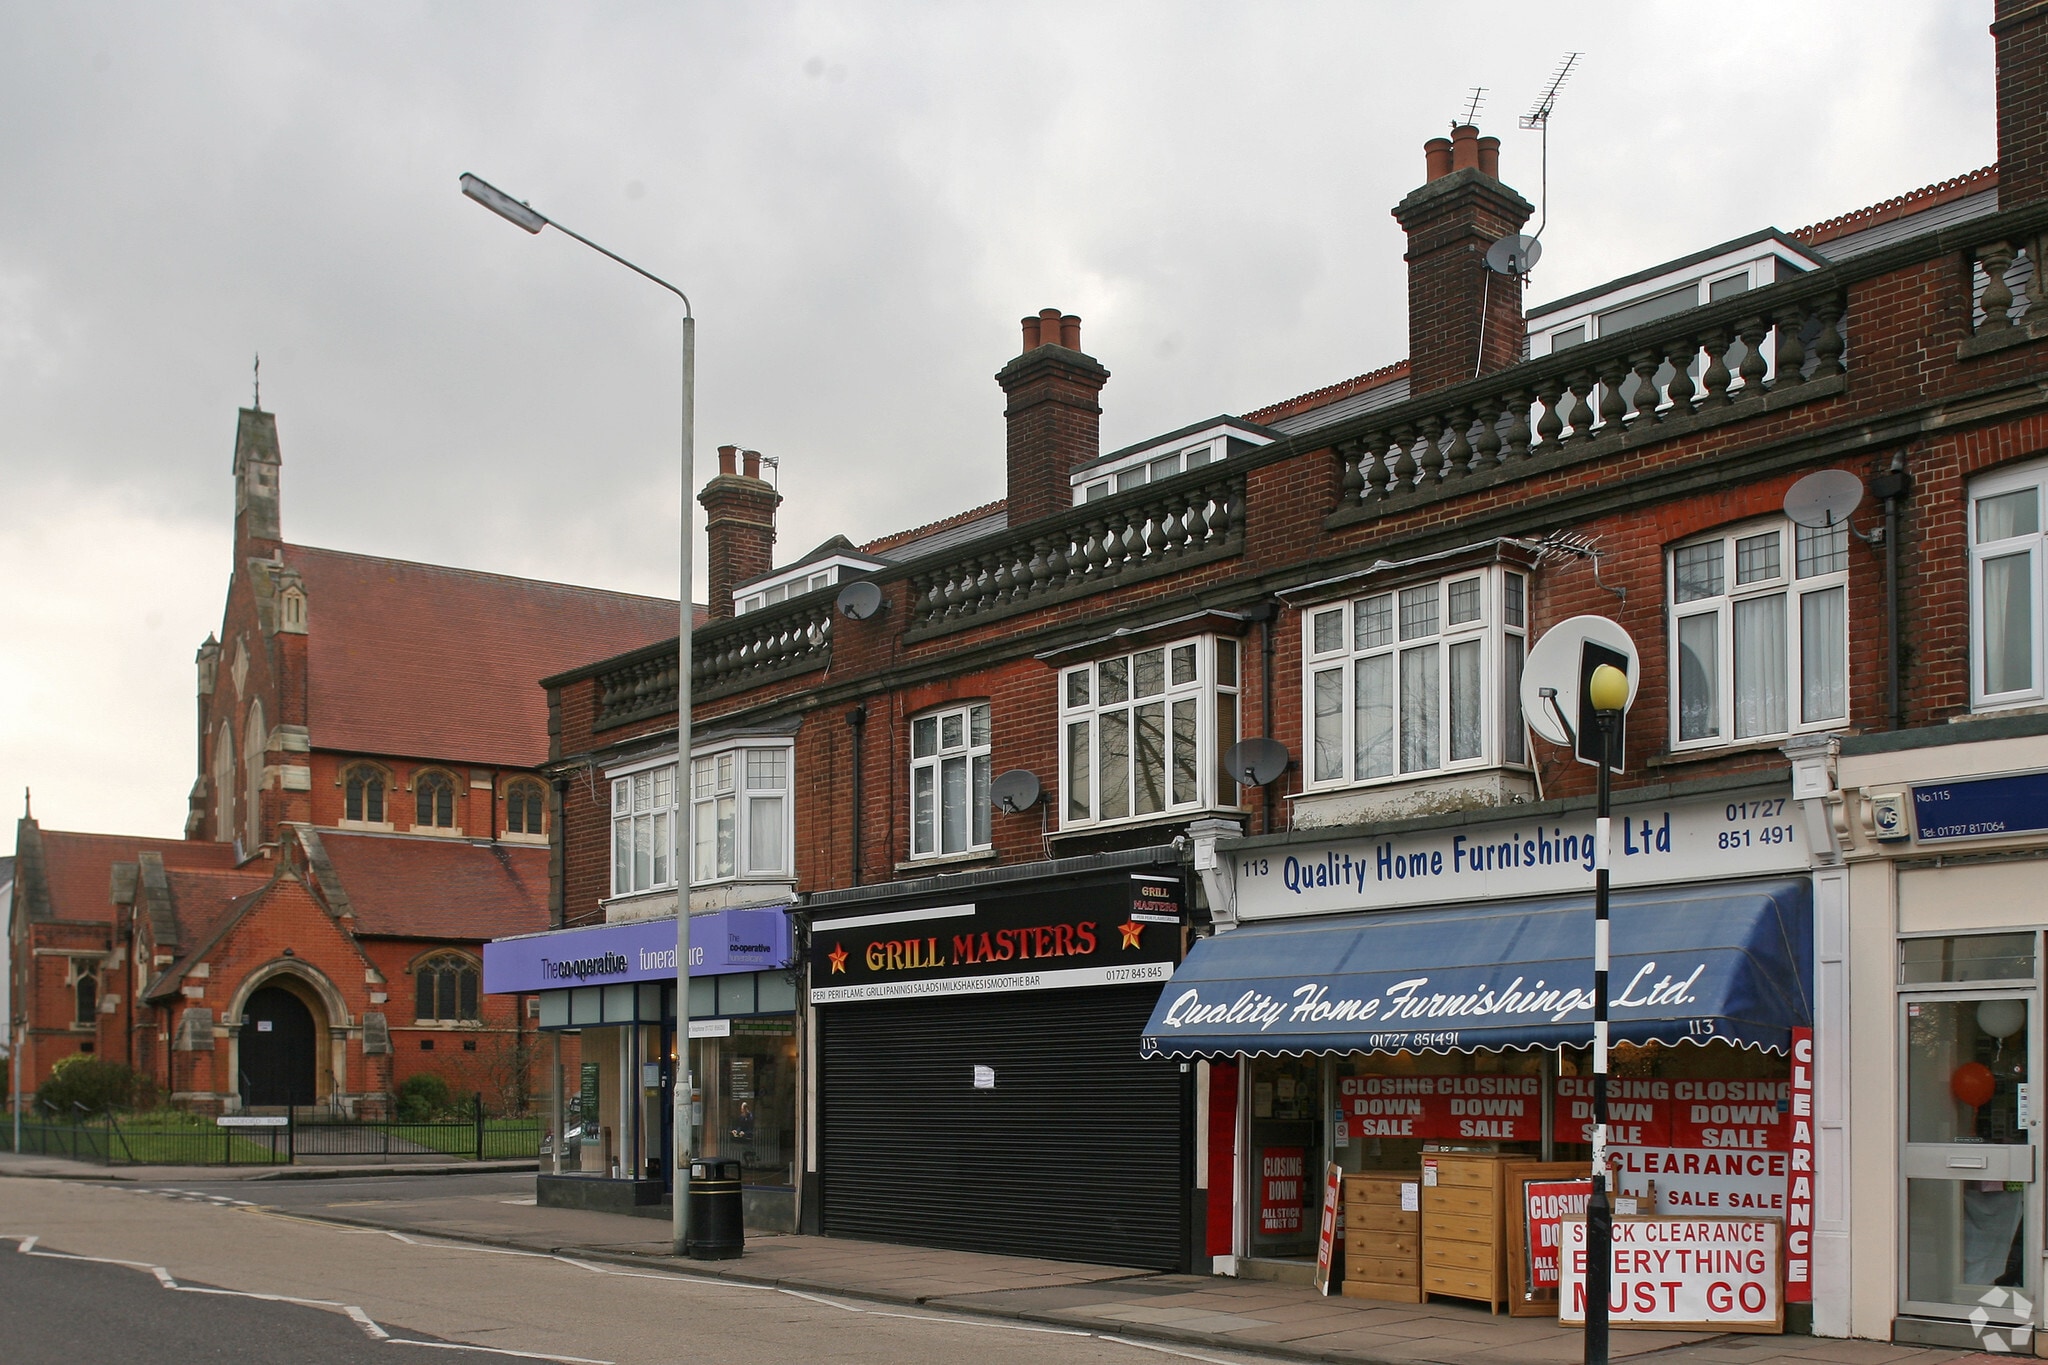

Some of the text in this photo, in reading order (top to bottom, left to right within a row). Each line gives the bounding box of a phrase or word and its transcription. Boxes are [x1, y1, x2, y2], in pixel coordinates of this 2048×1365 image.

[1916, 791, 1950, 803] No.115
[1726, 798, 1786, 822] 01727
[1718, 825, 1794, 850] 851 491
[1937, 824, 1966, 837] 01727
[1970, 821, 2005, 834] 817064
[1243, 812, 1671, 894] 113 Quality Home Furnishing Ltd
[1142, 886, 1169, 897] GRILL
[1133, 900, 1178, 912] MASTERS
[729, 933, 740, 942] The
[865, 921, 1097, 971] GRILL MASTERS
[729, 943, 771, 954] co-operative
[541, 944, 704, 982] The co-operative funeralre
[1026, 975, 1040, 986] BAR
[1106, 966, 1162, 980] 01727 845 845
[1163, 961, 1706, 1031] Quality Home Furnishings Ltd.
[1688, 1019, 1714, 1035] 113
[1142, 1037, 1158, 1050] 113
[1369, 1032, 1459, 1047] 01727 851491
[1342, 1078, 1434, 1095] CLOSING
[1437, 1077, 1538, 1096] CLOSING
[1674, 1081, 1791, 1101] CLOSING
[1354, 1099, 1421, 1115] DOWN
[1450, 1099, 1524, 1117] DOWN
[1572, 1101, 1653, 1122] DWN
[1690, 1105, 1779, 1125] DOWN
[1362, 1119, 1413, 1136] SALE
[1459, 1120, 1514, 1138] SALE
[1702, 1128, 1767, 1148] SALE
[1263, 1156, 1302, 1177] CLOSING
[1608, 1152, 1785, 1176] CLEARANCE
[1788, 1039, 1812, 1283] CLEARANCE
[1268, 1181, 1297, 1200] DOWN
[1668, 1190, 1720, 1207] SALE
[1728, 1193, 1783, 1209] SALE
[1262, 1207, 1300, 1218] ALL STOCK
[1264, 1218, 1298, 1229] MUST GO
[1540, 1223, 1560, 1247] DO
[1573, 1223, 1765, 1243] SCK CLEARANCE
[1534, 1256, 1554, 1269] ALL
[1573, 1250, 1766, 1274] EERYTHING
[1539, 1269, 1558, 1281] MU
[1706, 1281, 1767, 1313] GO
